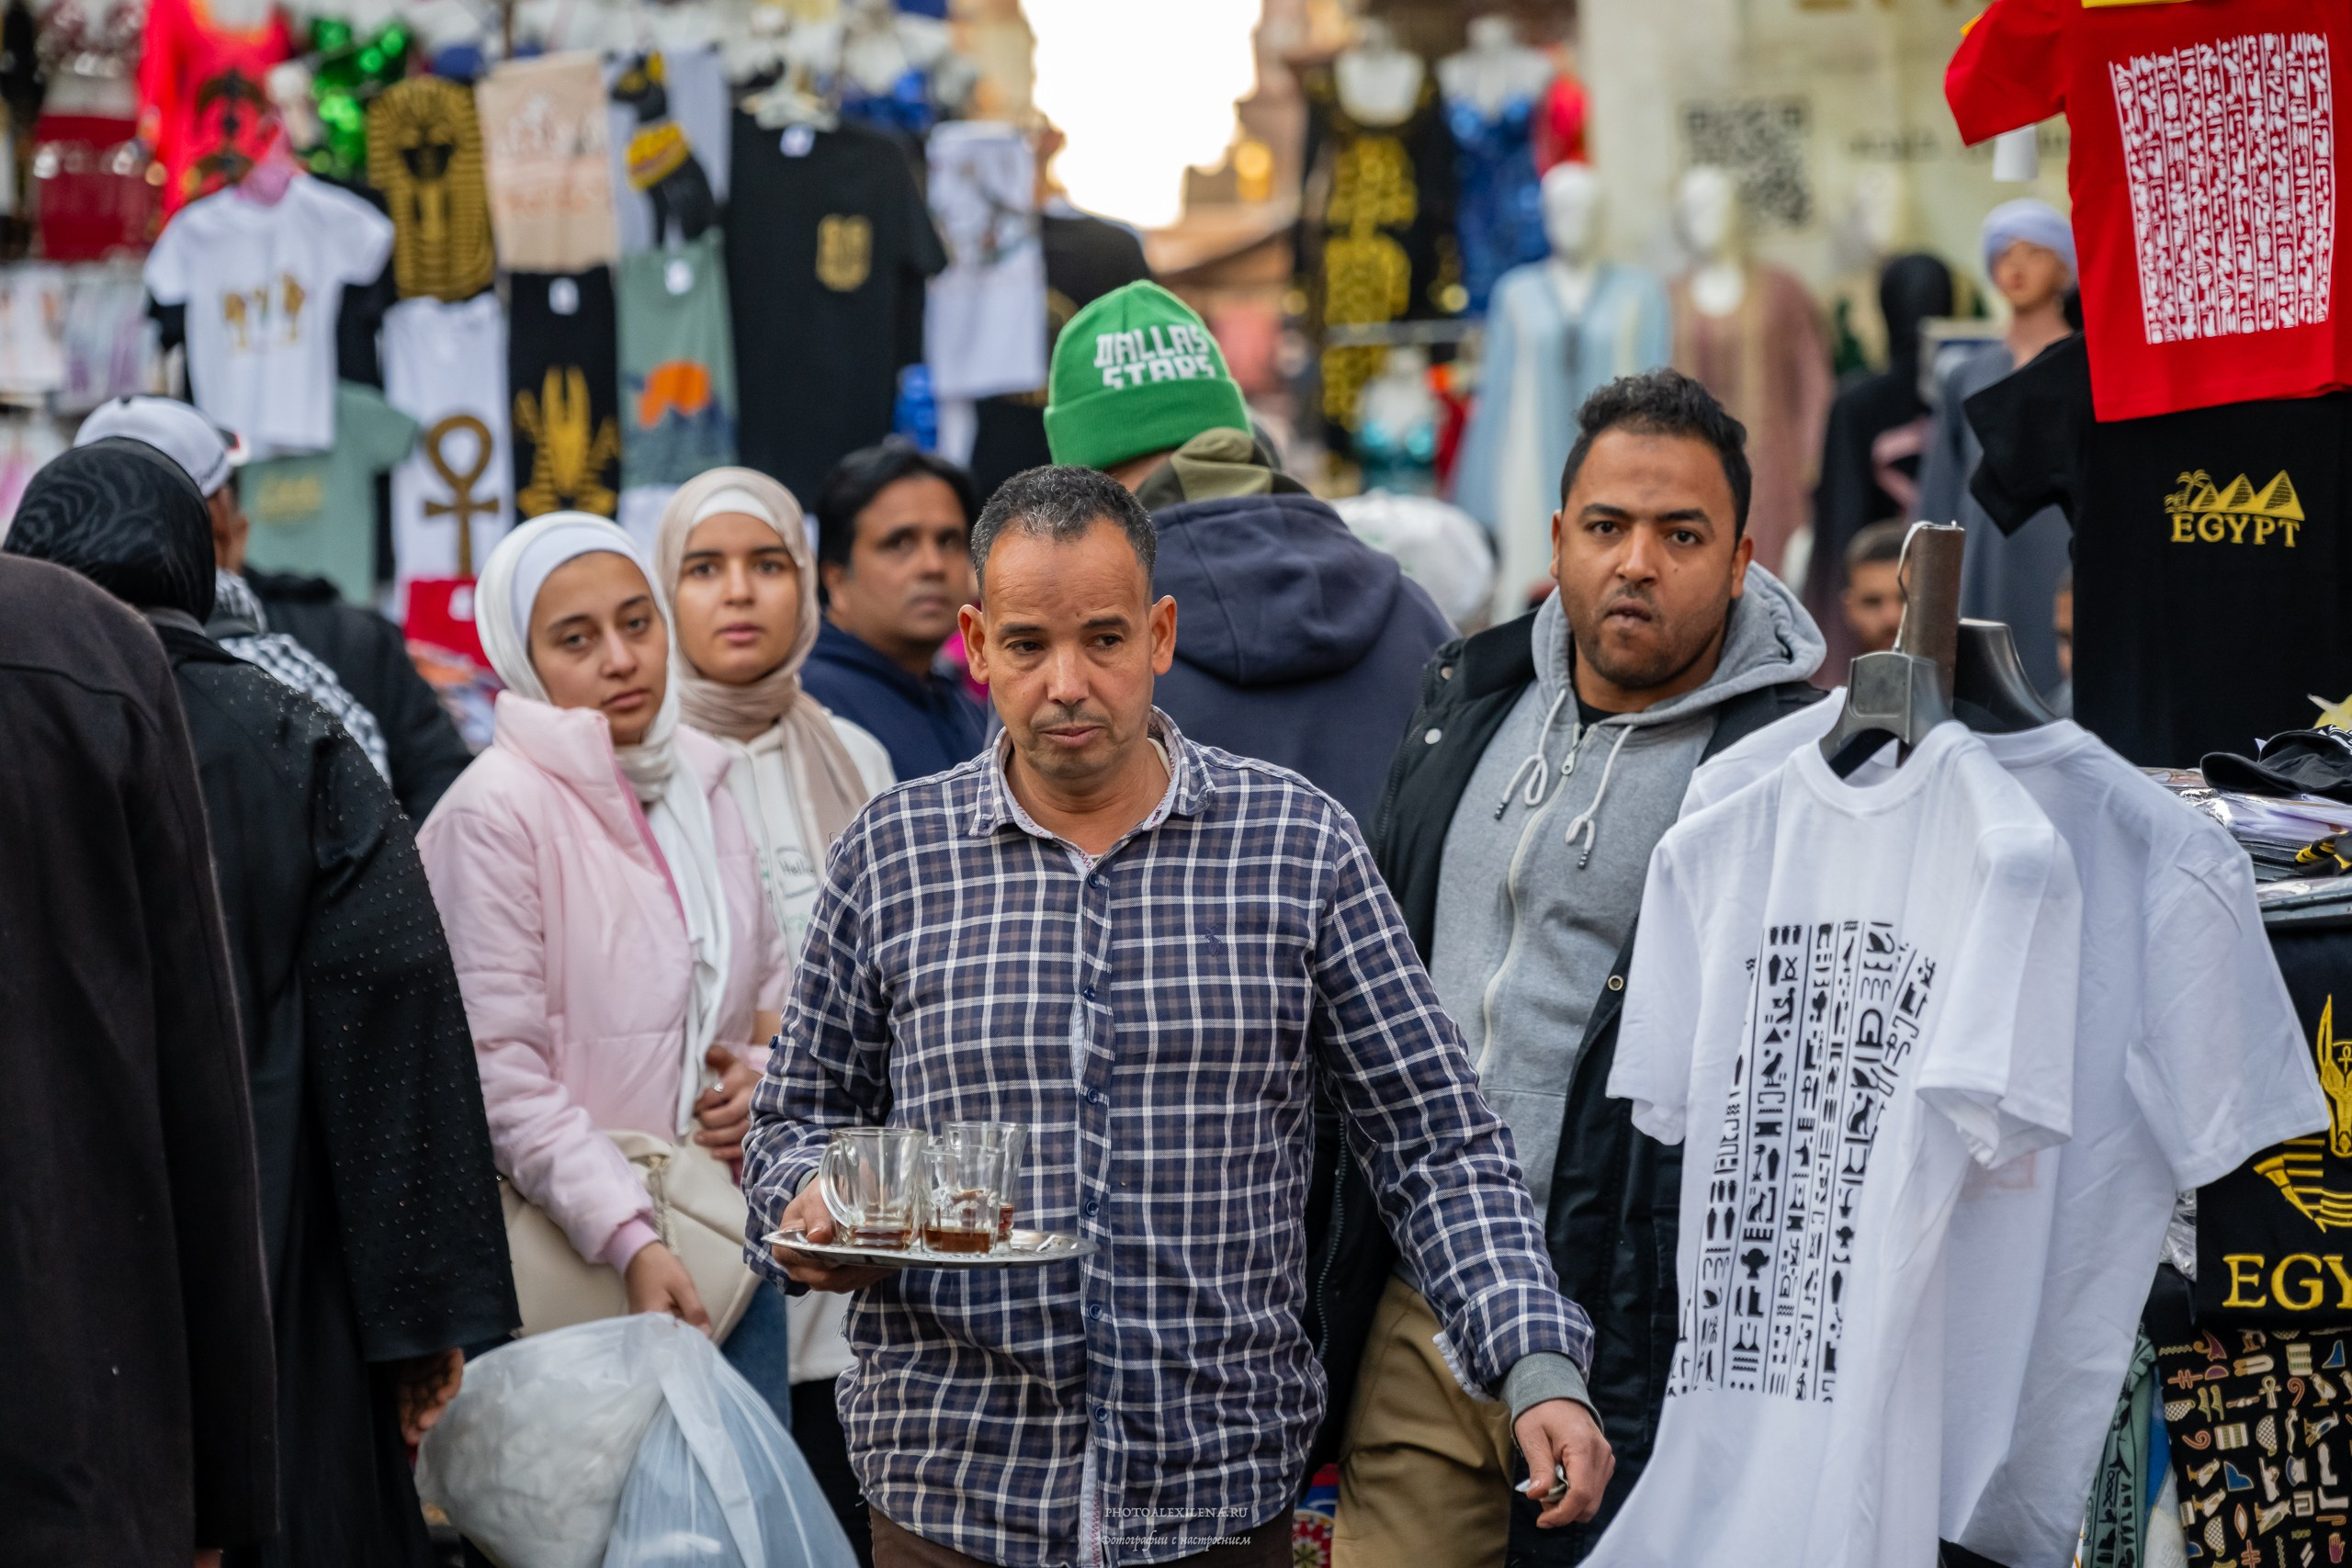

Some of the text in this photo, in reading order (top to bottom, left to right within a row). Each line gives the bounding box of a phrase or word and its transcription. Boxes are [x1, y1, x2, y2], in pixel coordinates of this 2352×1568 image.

[1093, 323, 1211, 368] DALLAS
[1102, 355, 1217, 390] STARS
[2170, 512, 2301, 547] EGYPT
